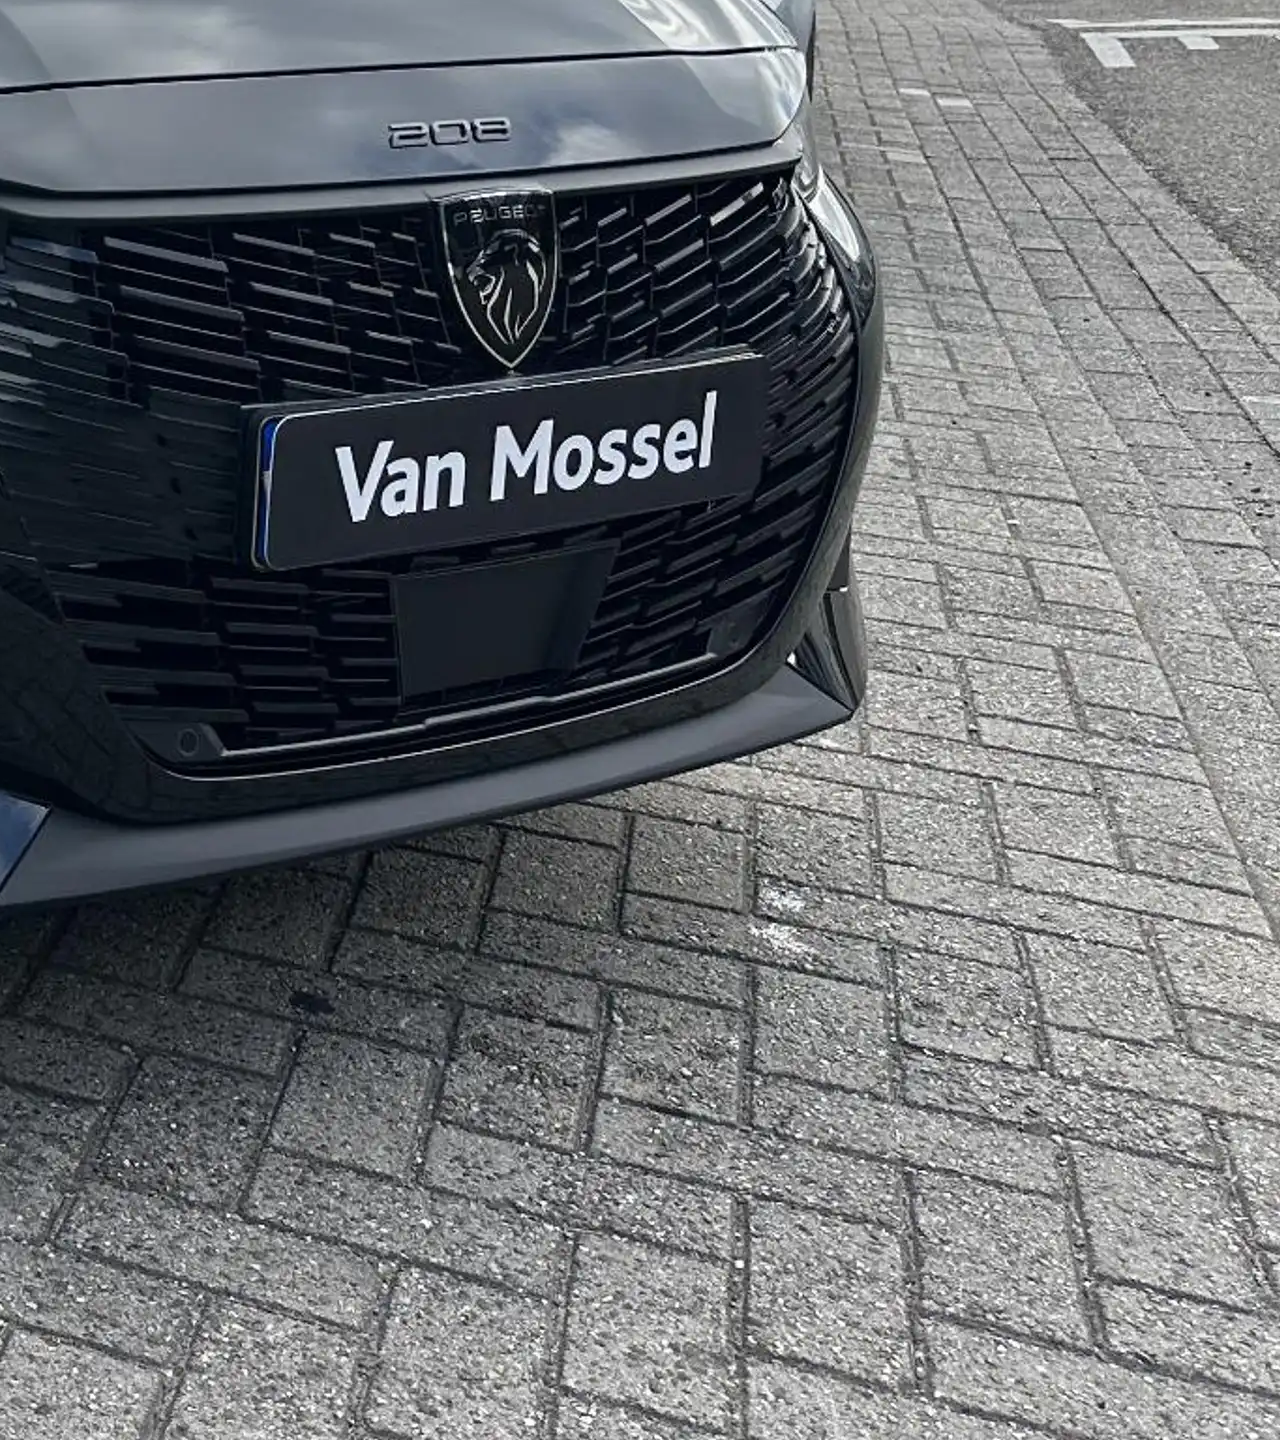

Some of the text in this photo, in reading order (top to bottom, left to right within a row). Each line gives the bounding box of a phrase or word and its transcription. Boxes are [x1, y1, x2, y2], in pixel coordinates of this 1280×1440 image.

[388, 117, 511, 149] 208
[335, 390, 718, 523] Van Mossel
